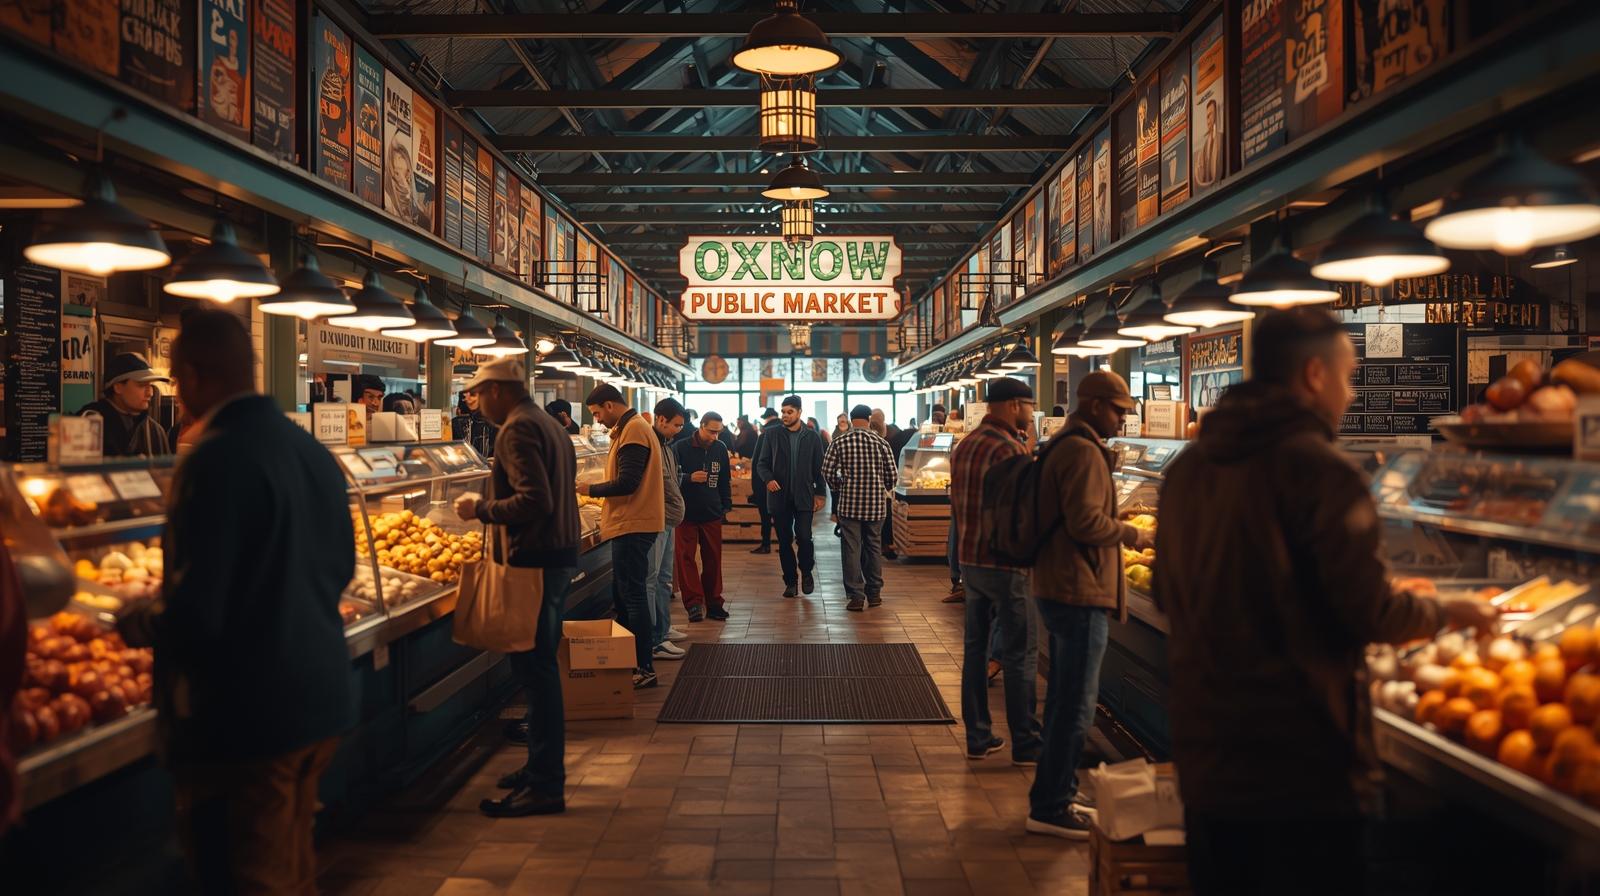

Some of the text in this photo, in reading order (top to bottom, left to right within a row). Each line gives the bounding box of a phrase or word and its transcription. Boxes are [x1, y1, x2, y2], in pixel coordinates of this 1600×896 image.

[694, 240, 891, 281] OXNOW
[691, 292, 888, 314] PUBLIC MARKET
